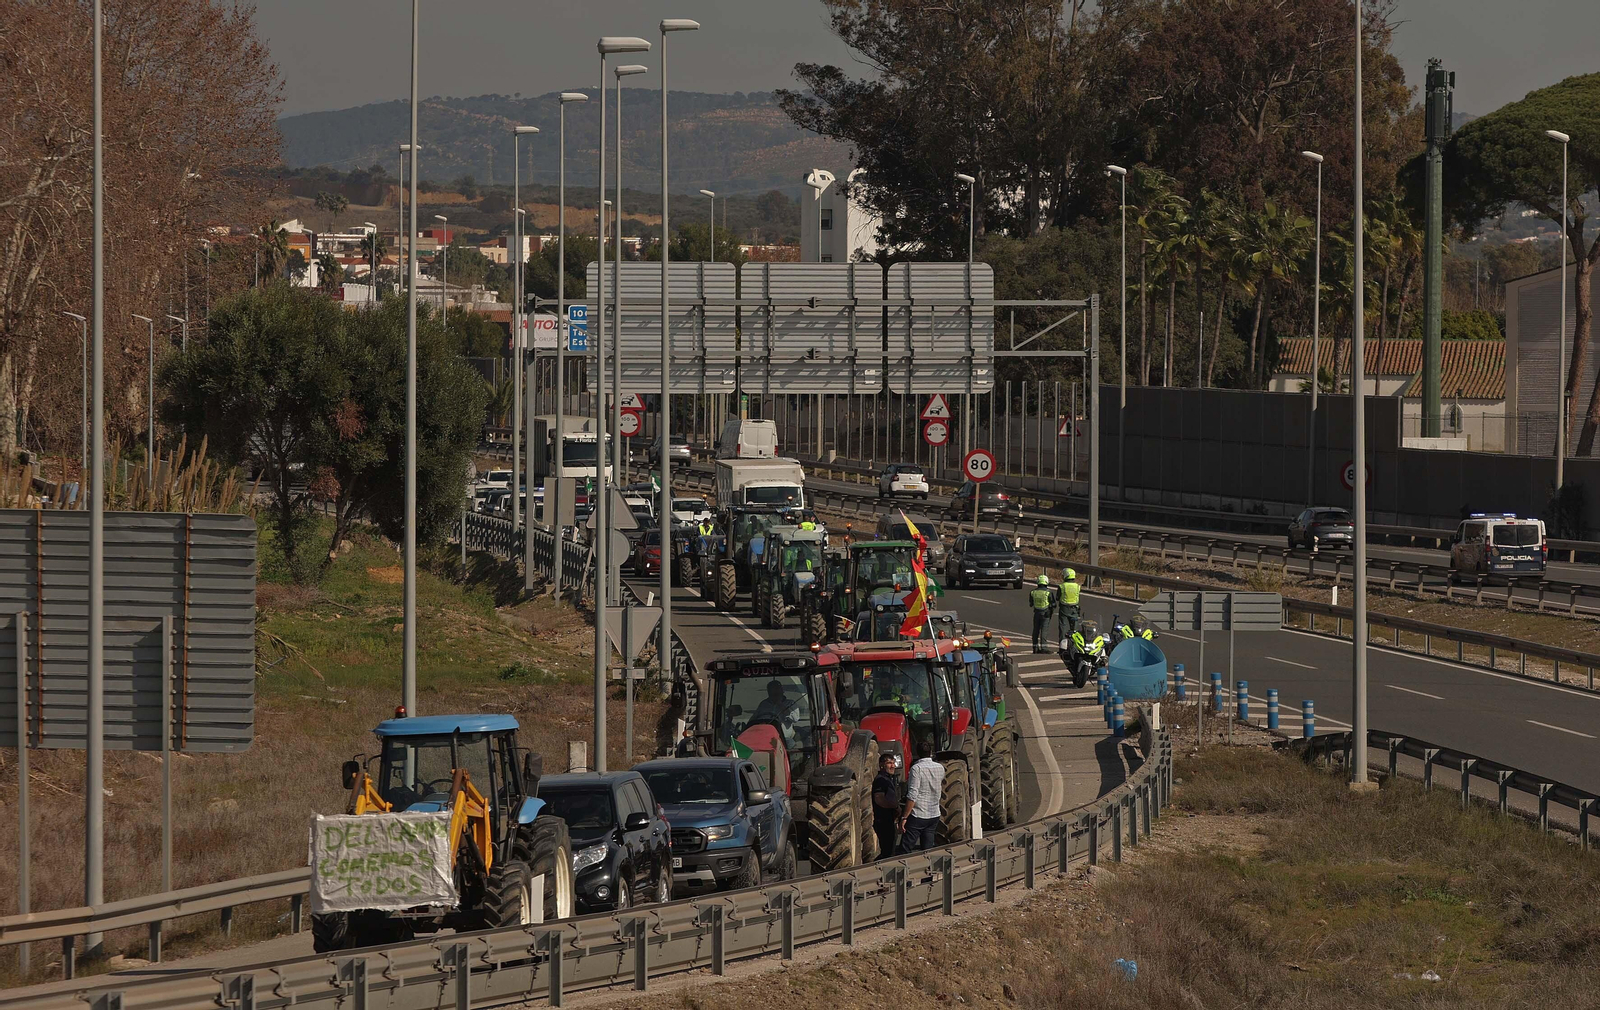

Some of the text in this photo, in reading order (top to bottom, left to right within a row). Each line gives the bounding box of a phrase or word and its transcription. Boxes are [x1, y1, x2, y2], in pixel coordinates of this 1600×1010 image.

[970, 459, 989, 471] 80
[324, 822, 377, 851] DEL
[338, 874, 423, 897] TODOS
